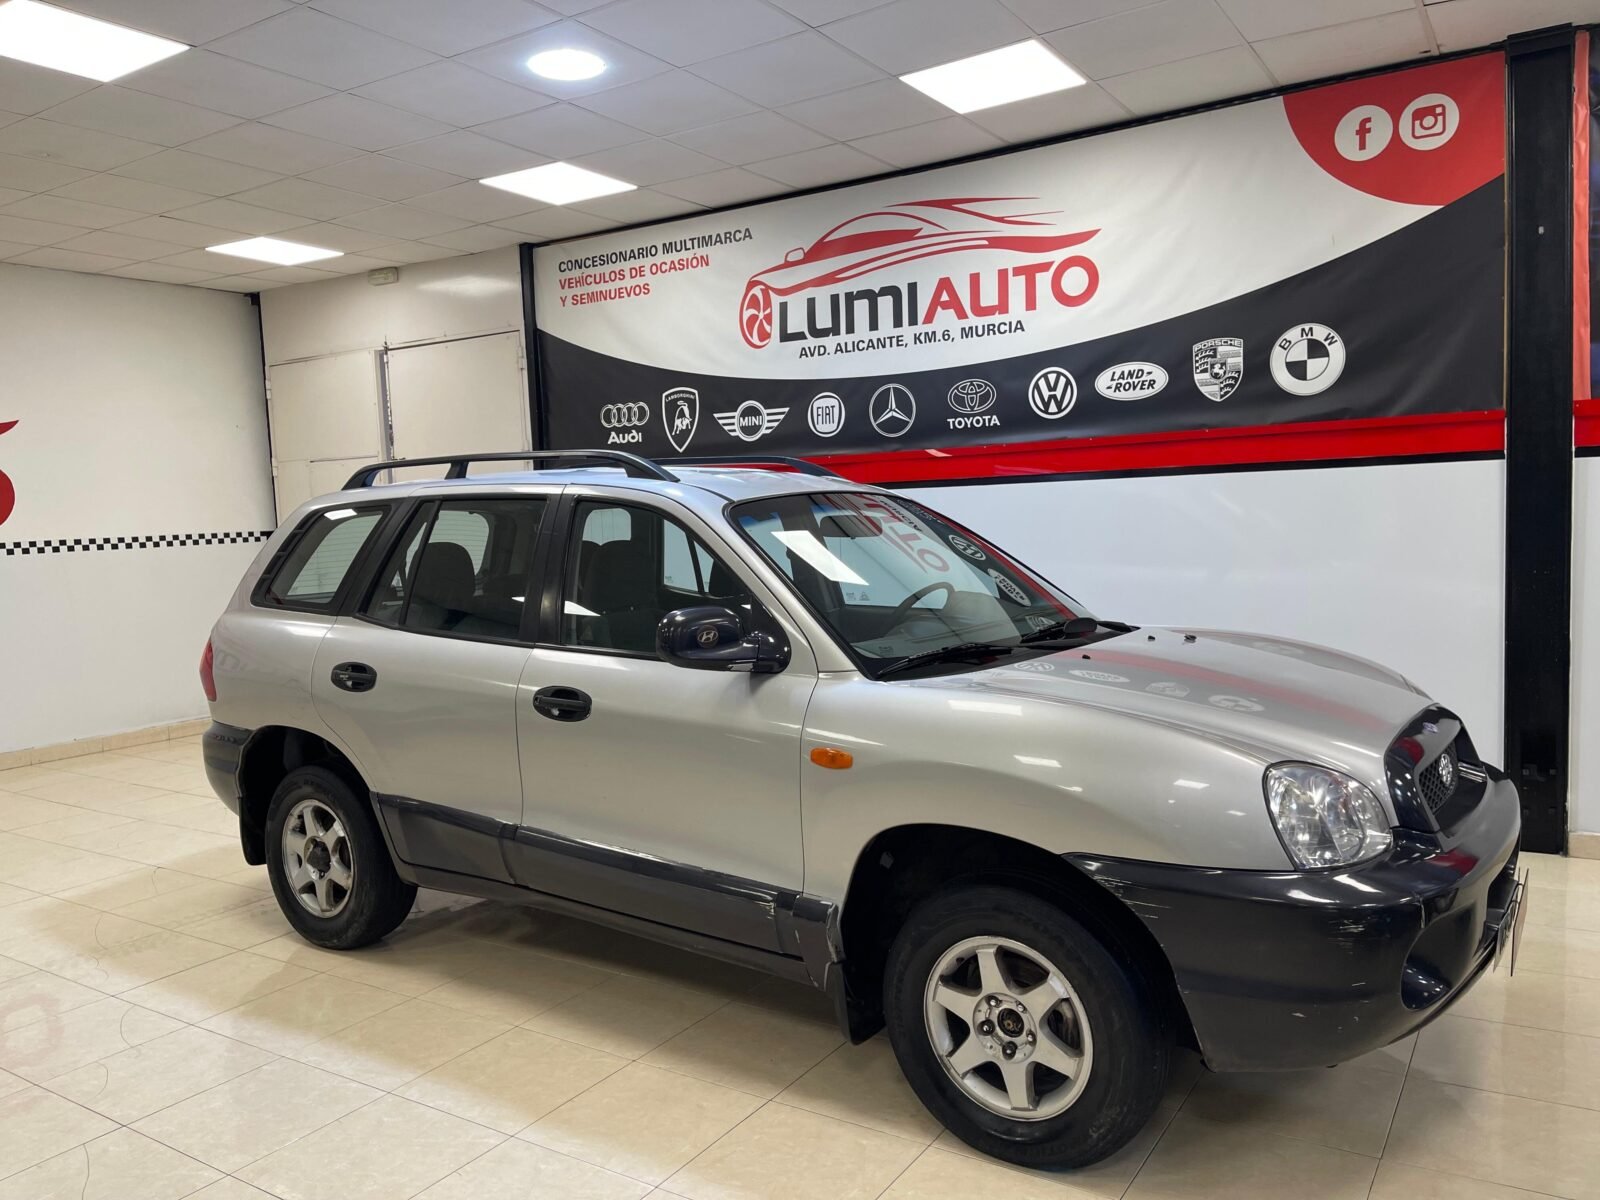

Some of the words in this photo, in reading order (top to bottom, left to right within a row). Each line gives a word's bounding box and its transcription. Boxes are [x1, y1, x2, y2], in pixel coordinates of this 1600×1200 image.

[558, 244, 658, 273] CONCESIONARIO
[662, 227, 753, 255] MULTIMARCA
[559, 267, 626, 290] VEHÍCULOS
[629, 265, 646, 280] DE
[649, 253, 710, 276] OCASIÓN
[559, 295, 568, 308] Y
[571, 282, 650, 306] SEMINUEVOS
[798, 343, 831, 359] AVD.
[834, 335, 909, 355] ALICANTE,
[913, 329, 955, 346] KM.6,
[960, 320, 1025, 340] MURCIA
[1195, 340, 1242, 352] PORSCHE
[1278, 326, 1338, 352] BMW
[739, 415, 762, 426] MINI
[816, 405, 837, 425] FIAT
[947, 414, 1000, 430] TOYOTA
[607, 430, 642, 444] Audi
